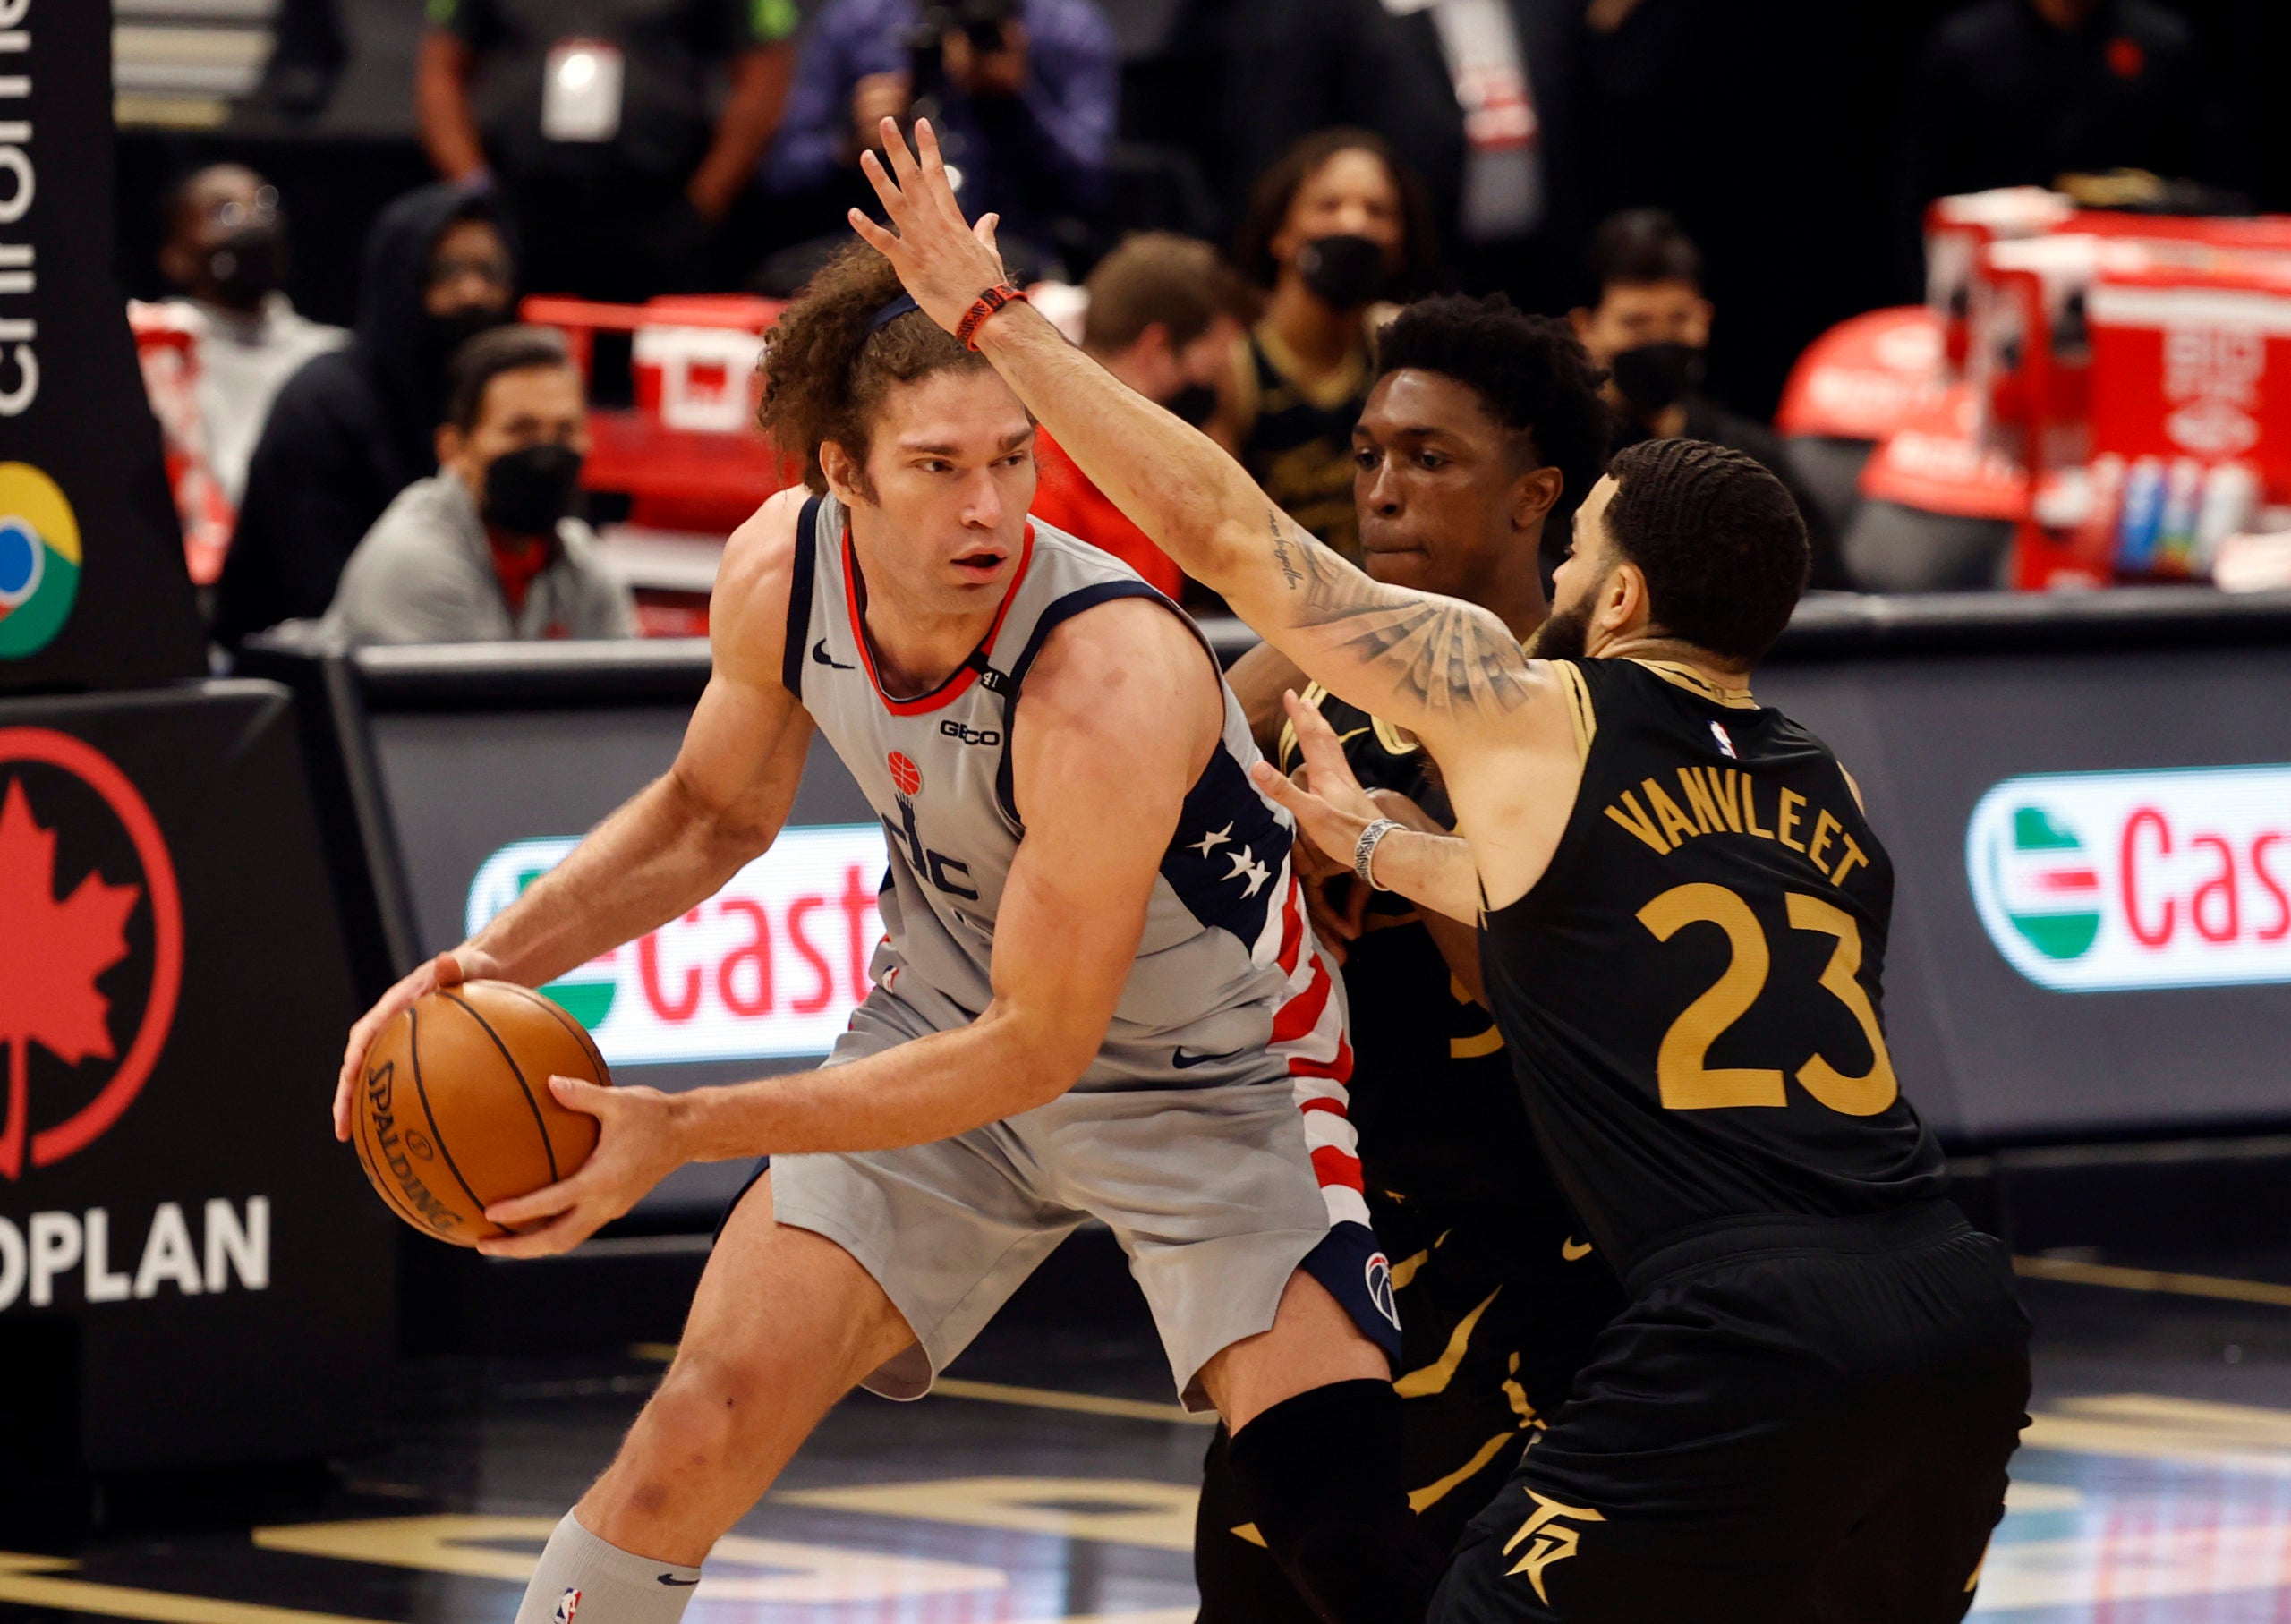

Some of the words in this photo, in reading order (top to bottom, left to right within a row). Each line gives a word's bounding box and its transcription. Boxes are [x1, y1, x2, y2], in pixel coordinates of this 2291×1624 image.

[983, 671, 1000, 688] 41
[1603, 766, 1869, 887] VANVLEET
[2120, 808, 2291, 946] Cas
[1635, 882, 1898, 1116] 23
[368, 1060, 464, 1231] SPALDING
